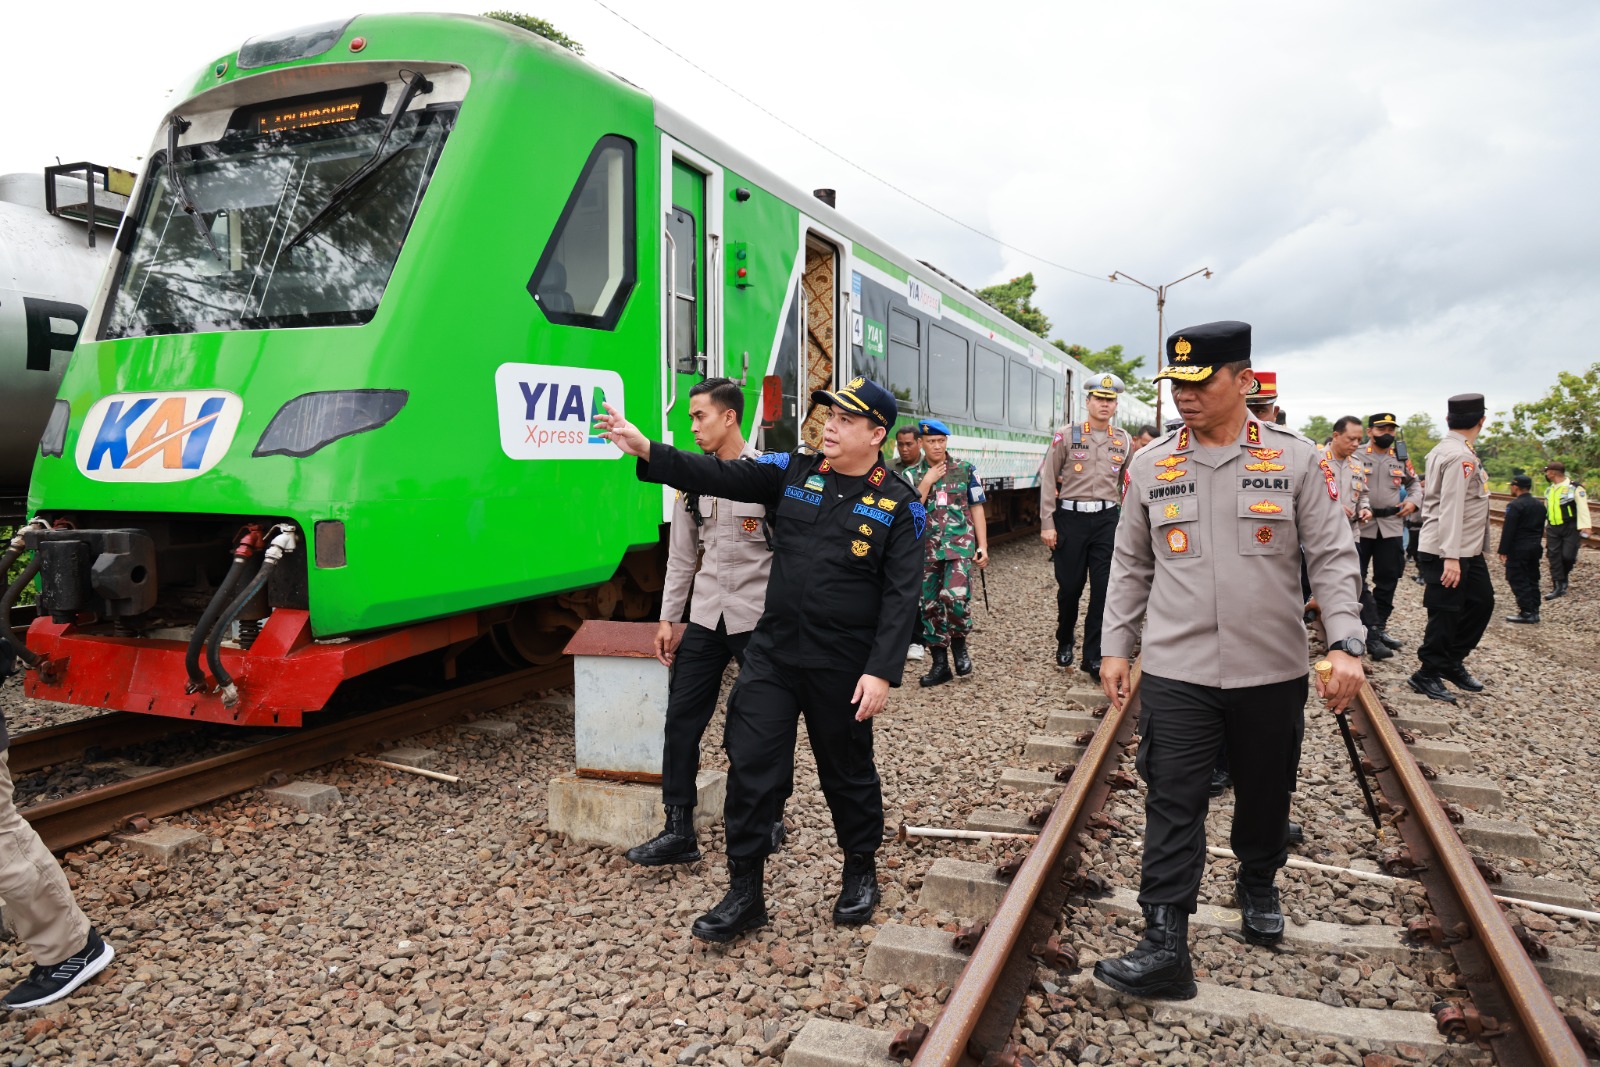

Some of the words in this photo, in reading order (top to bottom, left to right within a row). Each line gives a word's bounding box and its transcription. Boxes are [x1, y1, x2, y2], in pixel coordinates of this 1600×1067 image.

[908, 279, 920, 301] YIA
[854, 318, 860, 337] 4
[518, 381, 586, 422] YIA
[86, 397, 226, 471] KAI
[525, 424, 584, 448] Xpress
[1149, 484, 1187, 500] SUWONDO
[1242, 478, 1288, 490] POLRI
[857, 505, 890, 523] POLSUSKA
